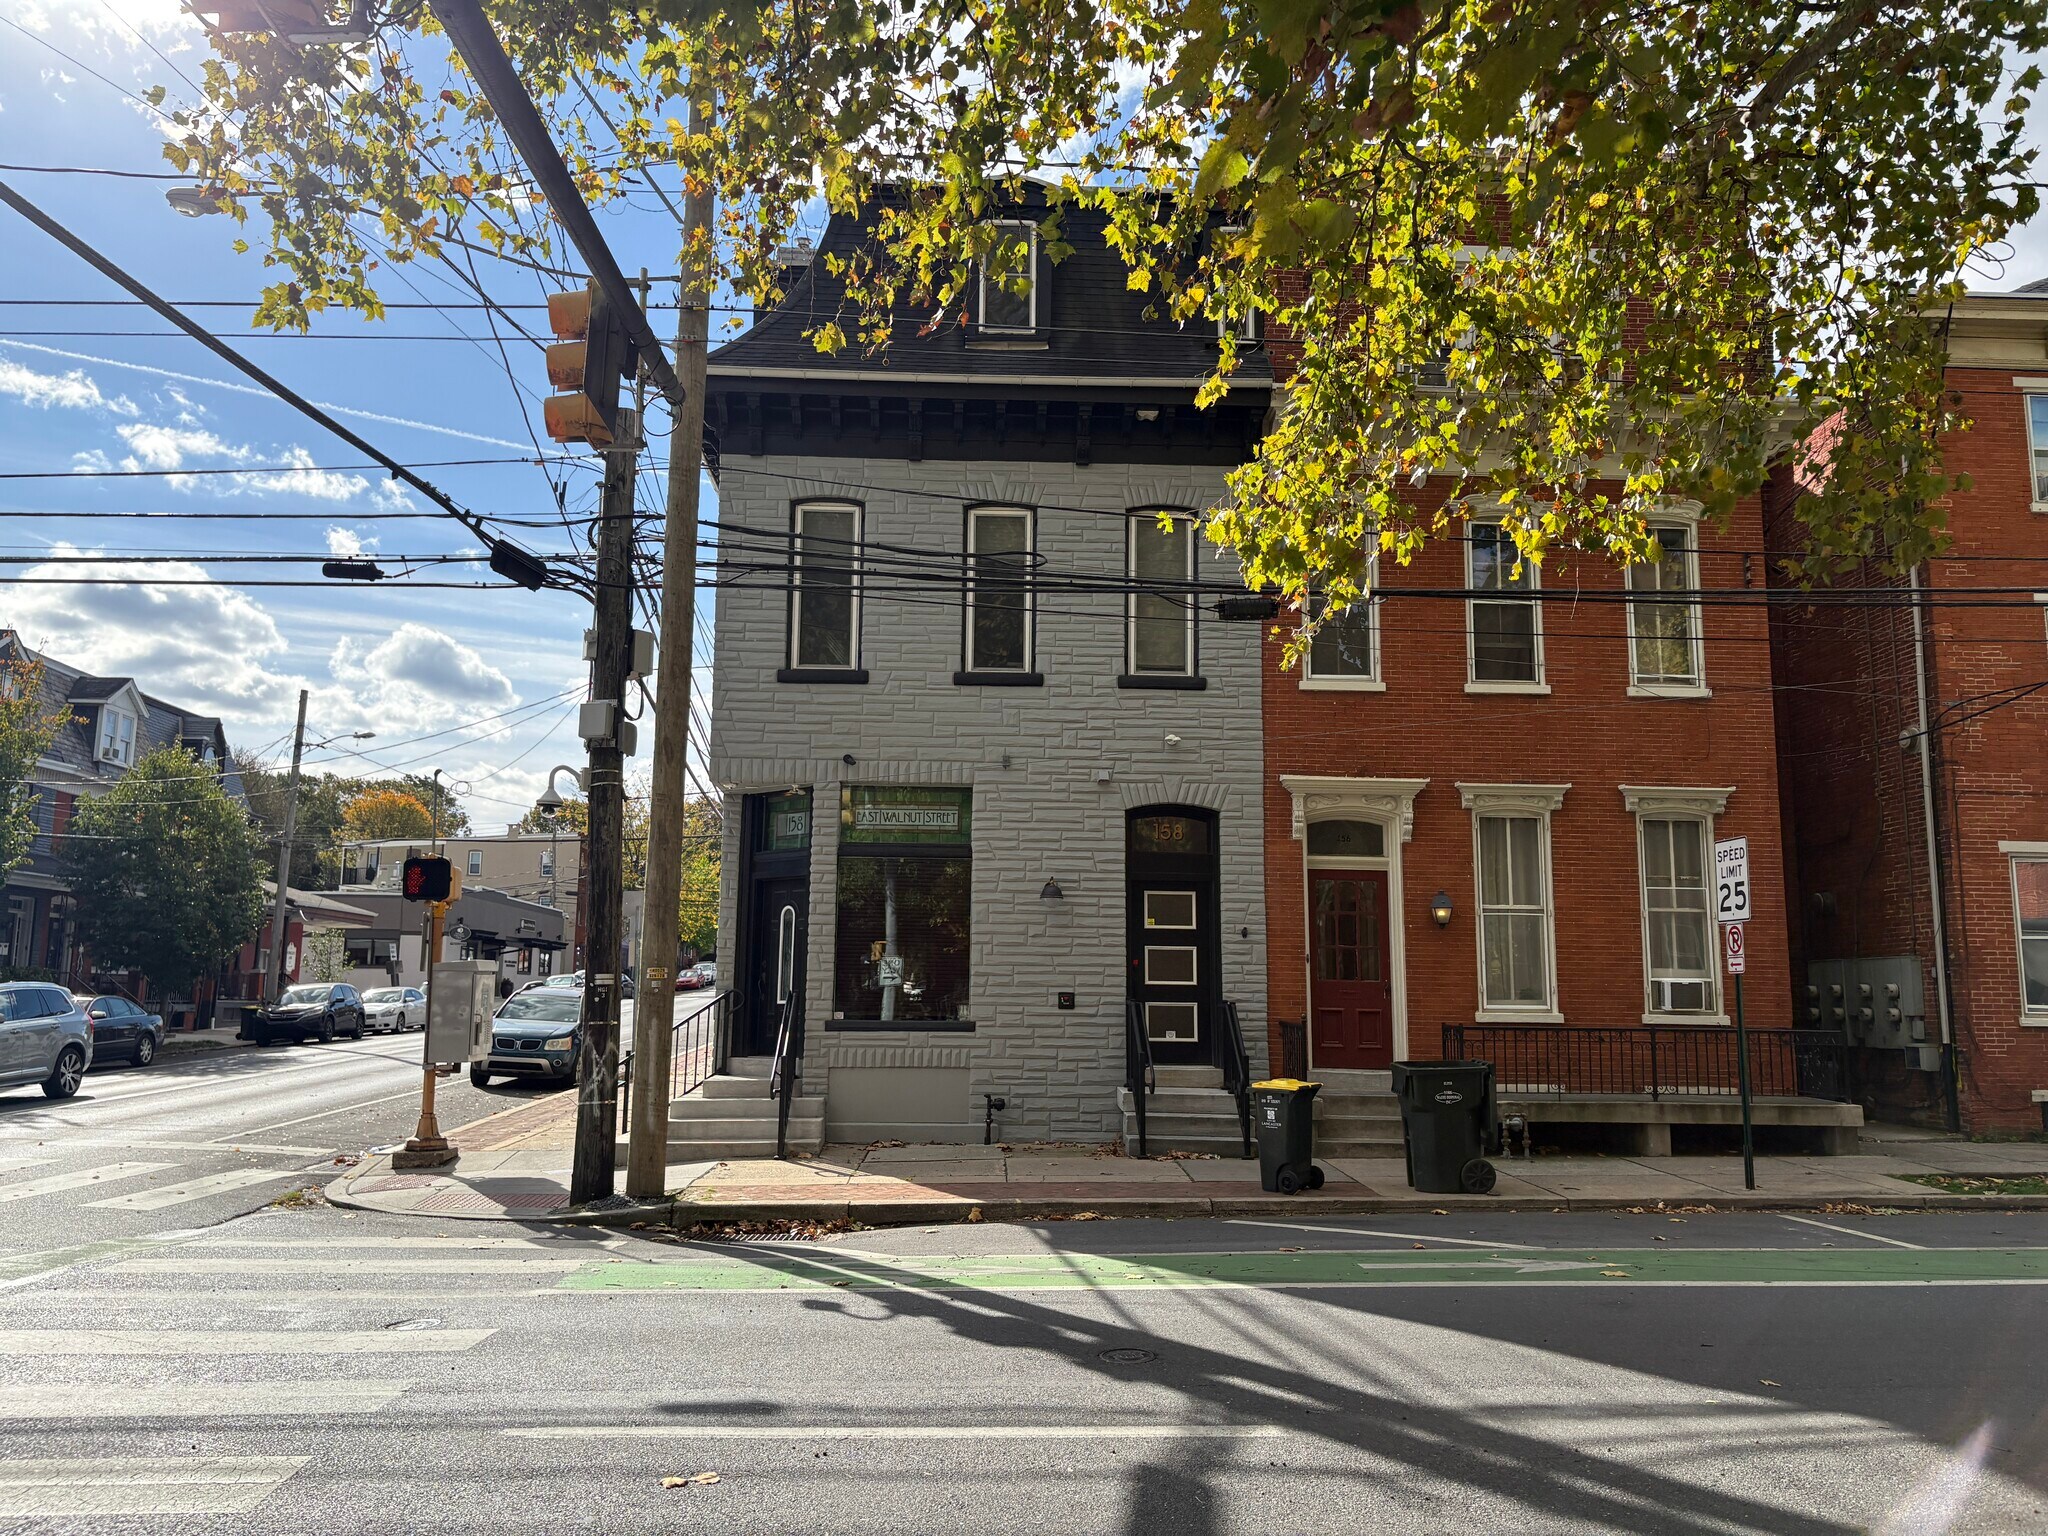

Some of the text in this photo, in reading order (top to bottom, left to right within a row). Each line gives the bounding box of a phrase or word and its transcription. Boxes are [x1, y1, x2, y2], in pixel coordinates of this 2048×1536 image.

[788, 816, 804, 832] 158
[856, 811, 957, 823] EAST WALNUT STREET
[1153, 823, 1183, 840] 158
[1717, 847, 1745, 863] SPEED
[1720, 864, 1743, 879] LIMIT
[1719, 880, 1747, 913] 25
